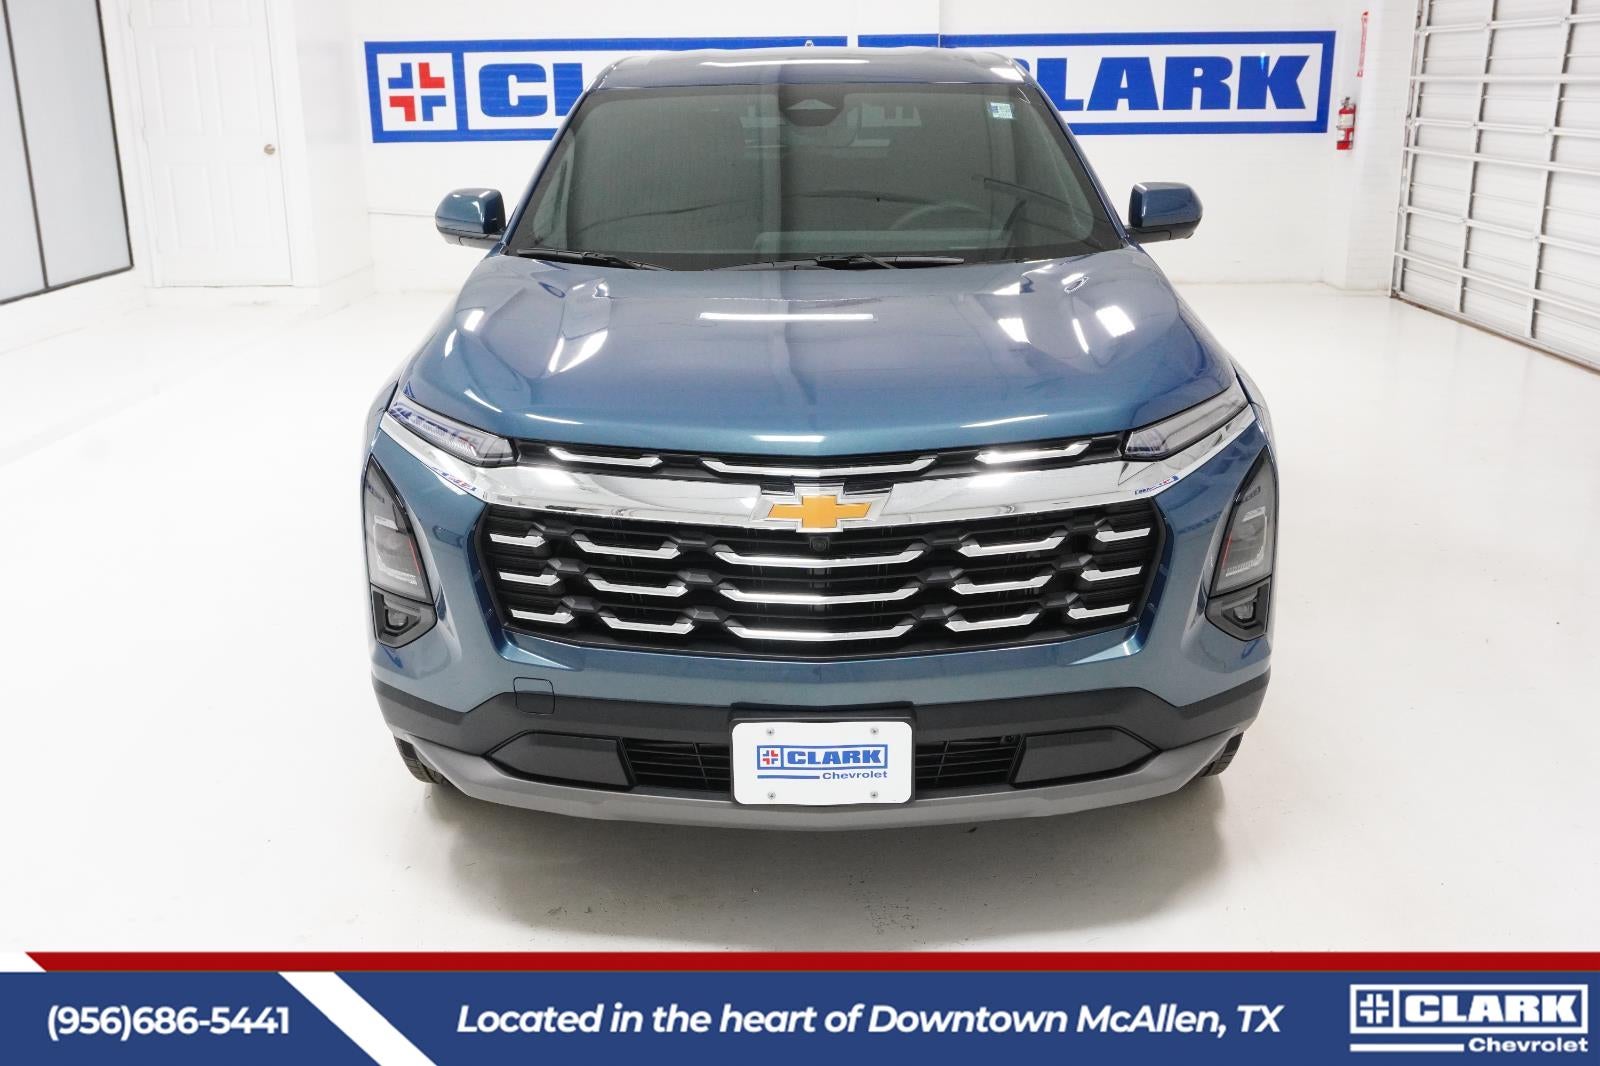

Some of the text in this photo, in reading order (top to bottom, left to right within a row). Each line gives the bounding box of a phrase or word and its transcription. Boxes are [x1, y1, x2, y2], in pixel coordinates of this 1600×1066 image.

[1013, 56, 1308, 112] LARK
[787, 749, 882, 765] CLARK
[822, 770, 888, 780] Chevrolet
